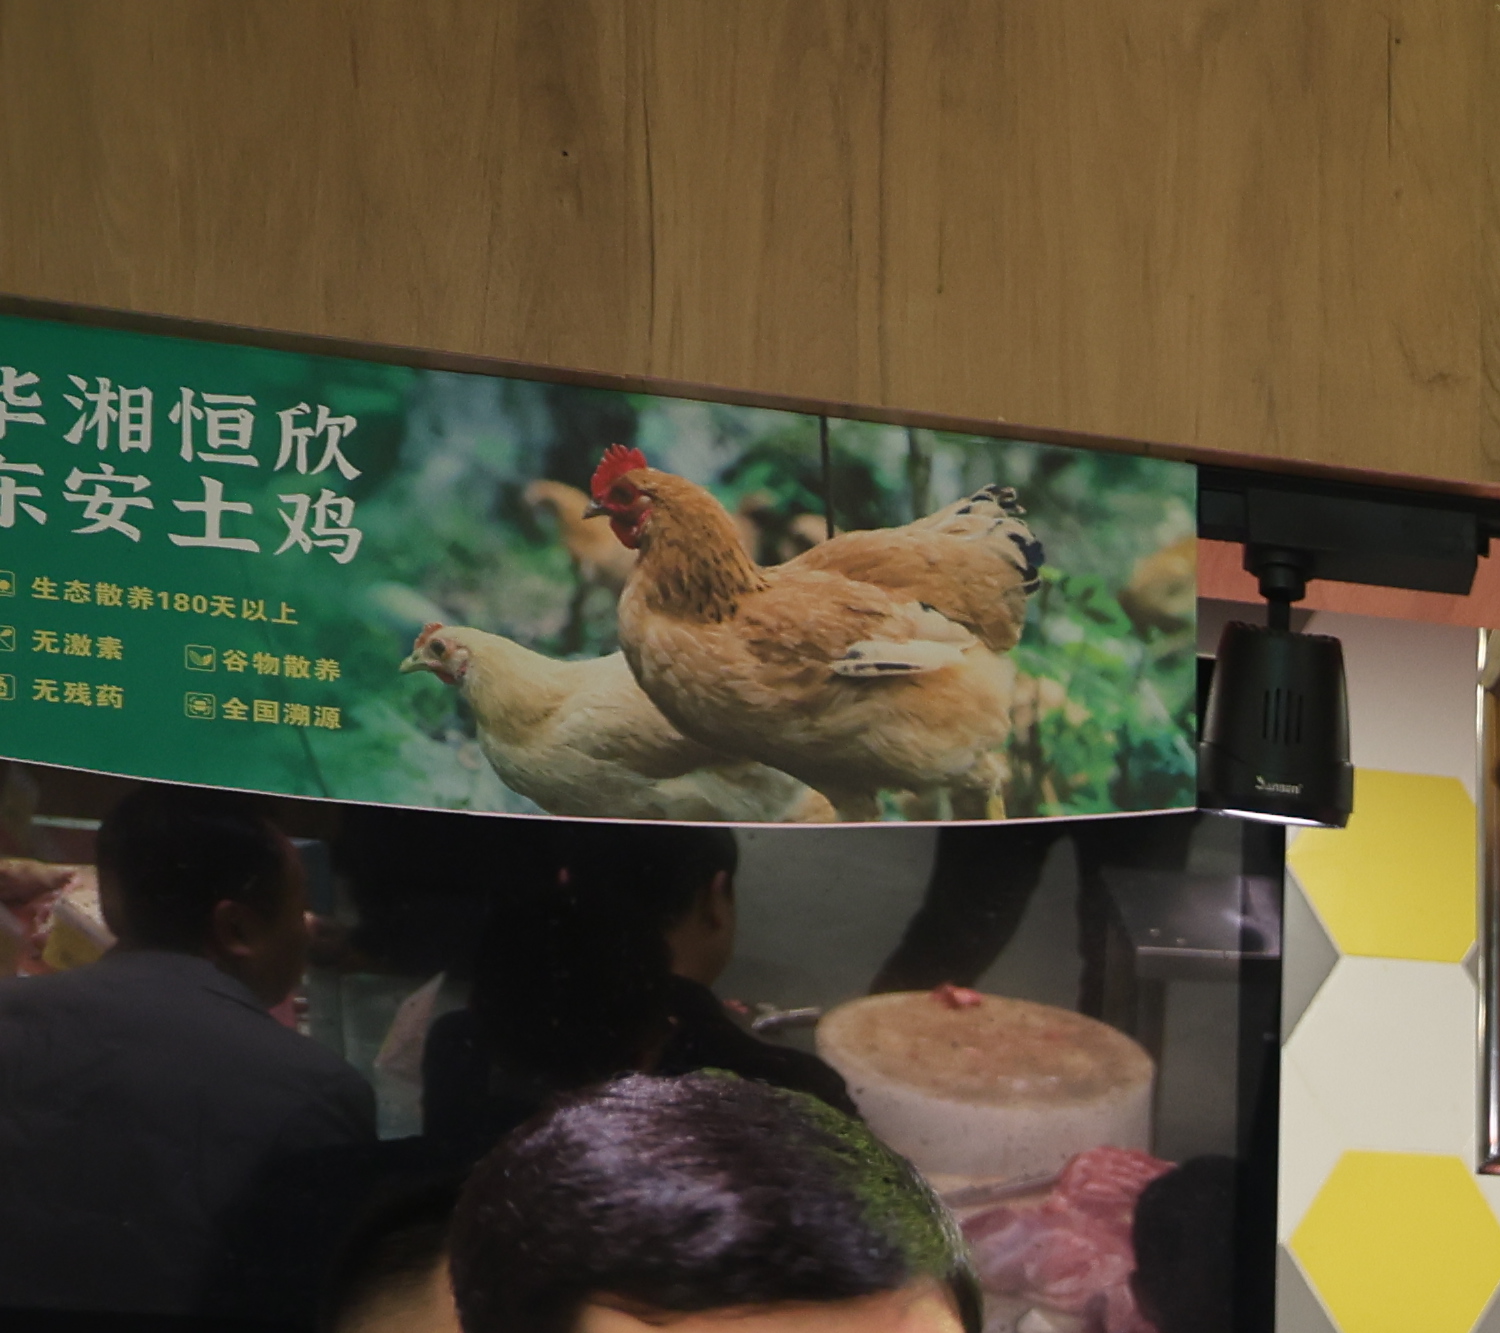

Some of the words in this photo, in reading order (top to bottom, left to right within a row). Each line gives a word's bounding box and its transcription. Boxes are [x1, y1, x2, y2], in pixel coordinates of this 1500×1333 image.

[31, 576, 299, 625] 生态散养180天以上
[32, 629, 124, 660] 无激素
[222, 648, 341, 682] 谷物散养
[32, 678, 124, 709] 无残药
[222, 697, 342, 730] 全国溯源
